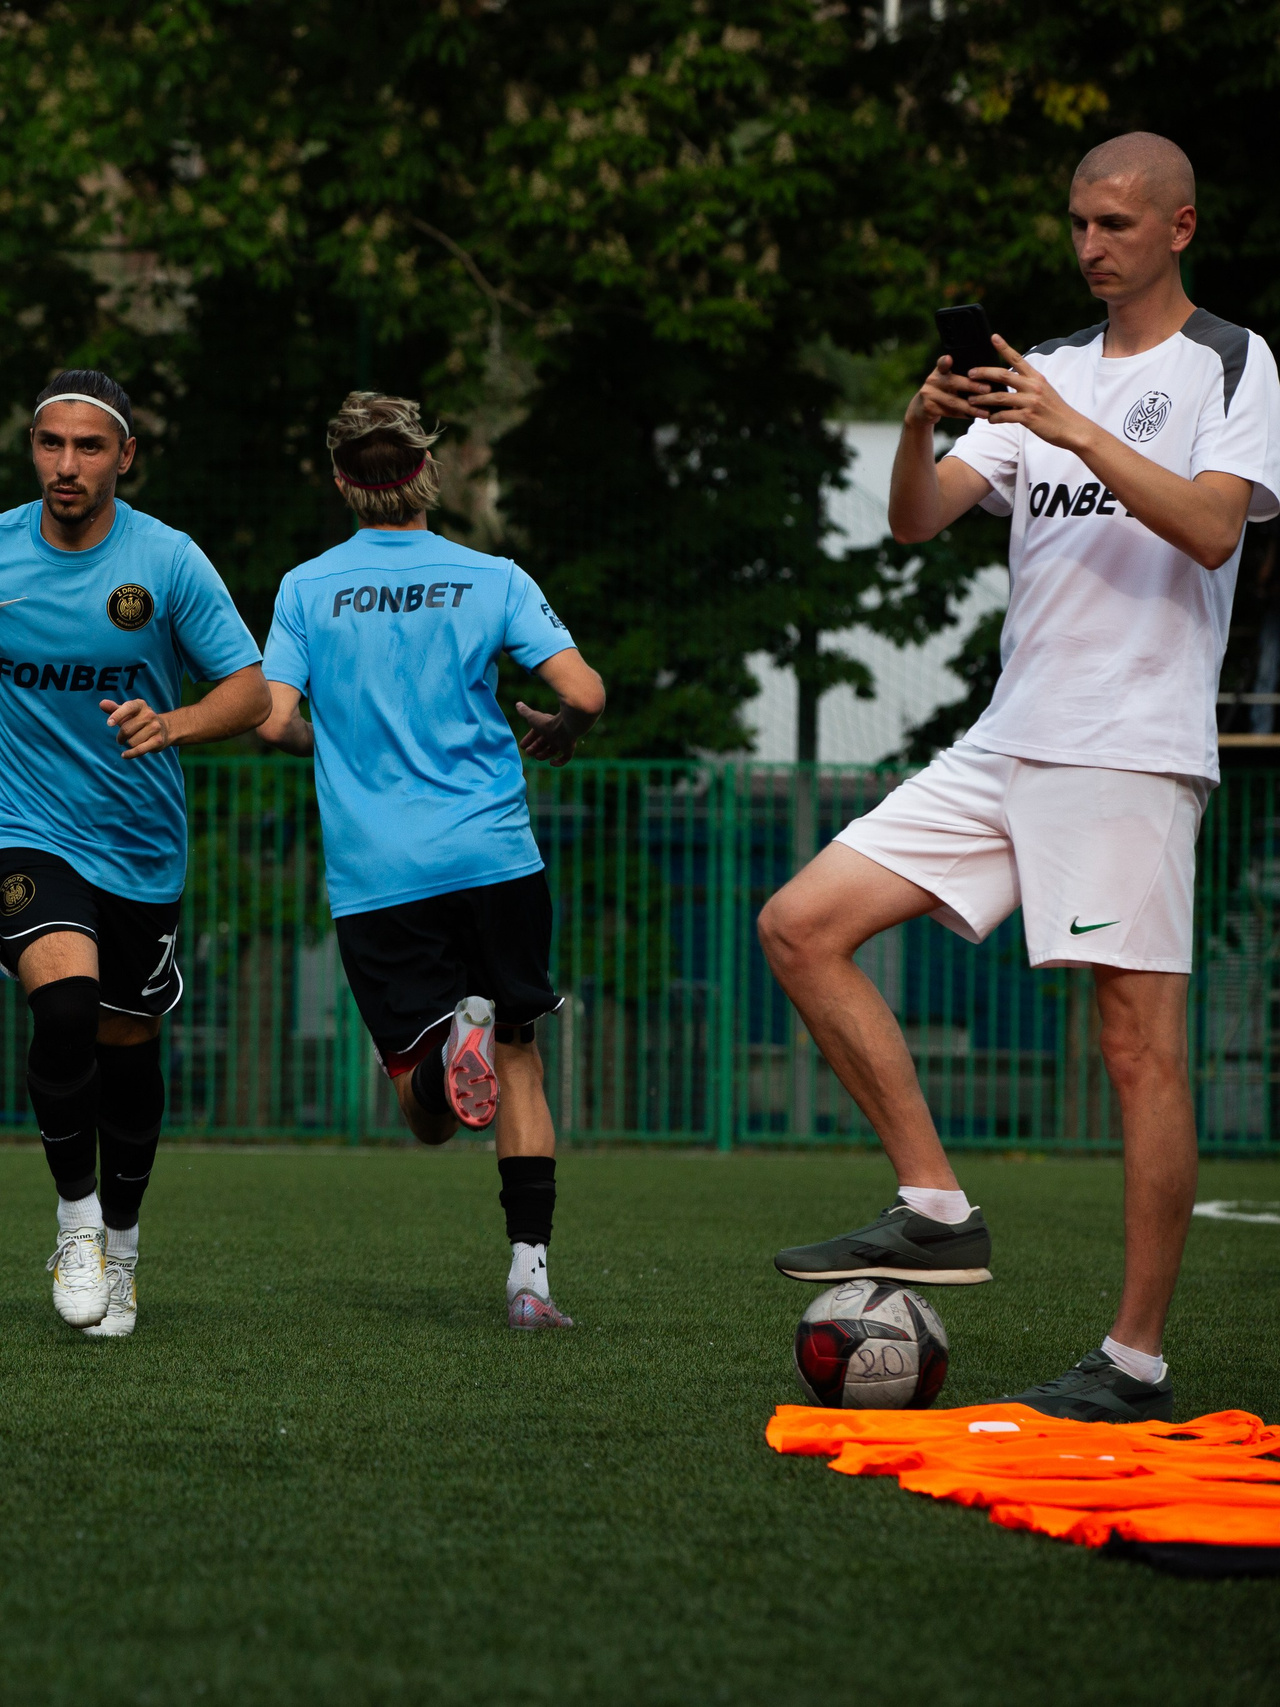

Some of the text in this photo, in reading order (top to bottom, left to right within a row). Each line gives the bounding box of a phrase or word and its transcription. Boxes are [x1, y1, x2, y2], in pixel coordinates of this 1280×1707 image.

[1028, 481, 1136, 518] ONBE
[122, 587, 145, 597] DROTS
[332, 582, 474, 618] FONBET
